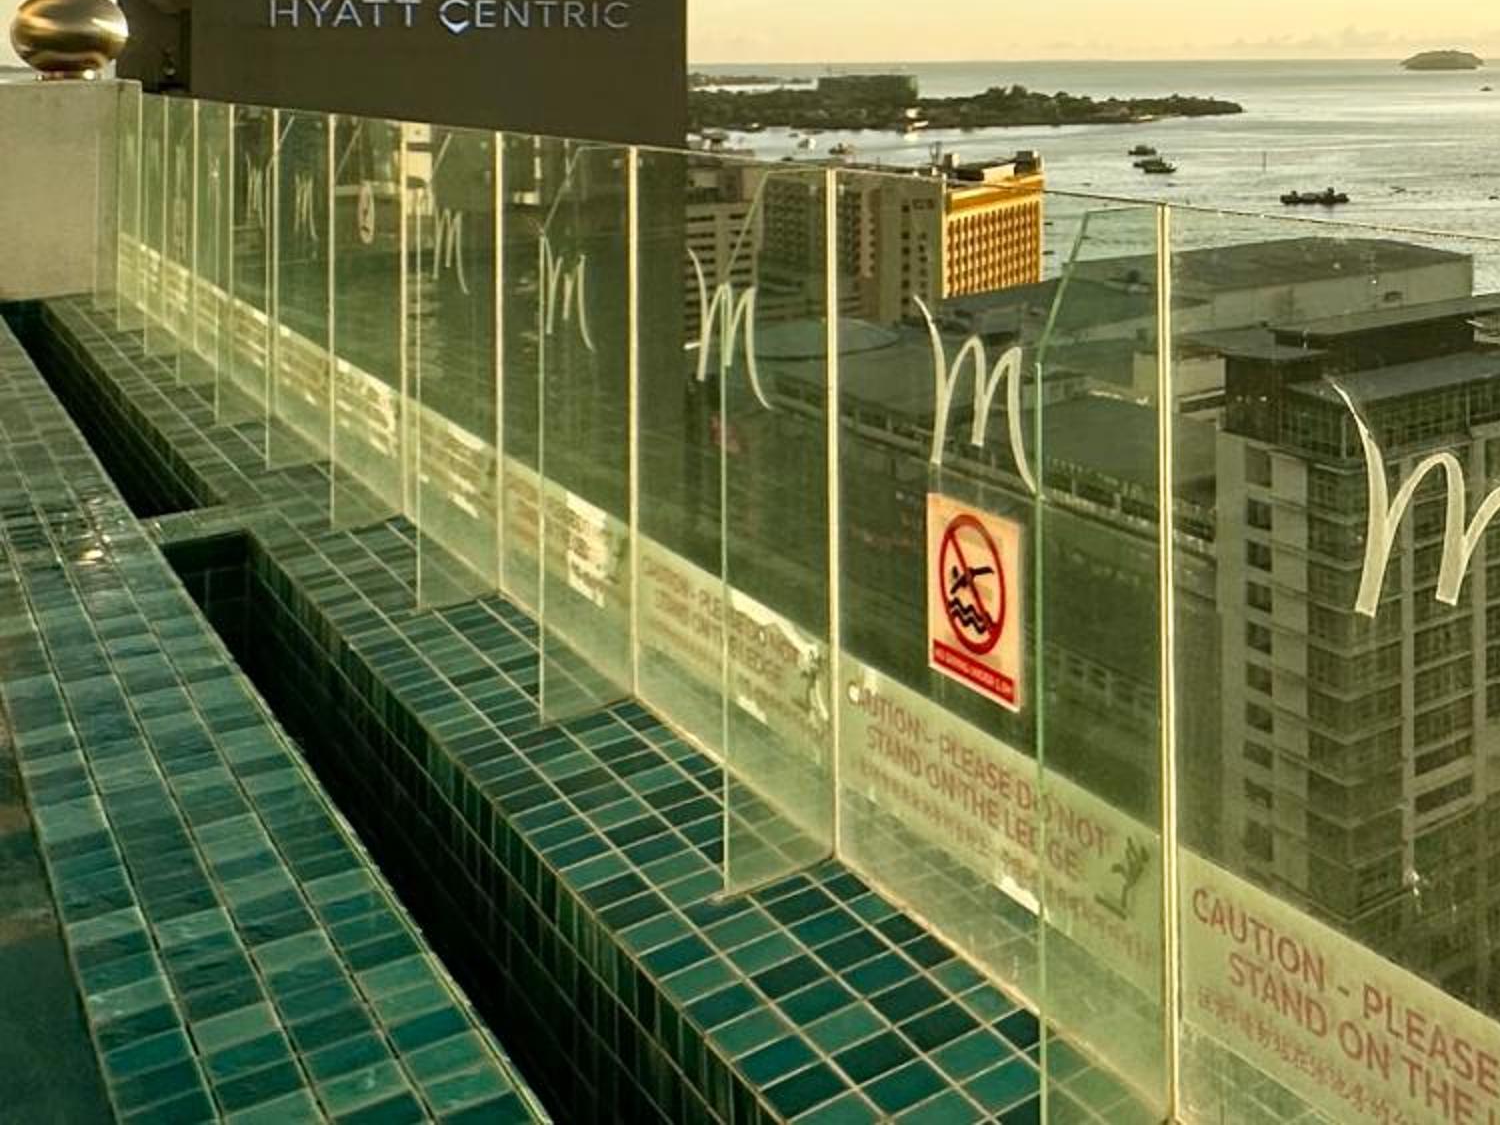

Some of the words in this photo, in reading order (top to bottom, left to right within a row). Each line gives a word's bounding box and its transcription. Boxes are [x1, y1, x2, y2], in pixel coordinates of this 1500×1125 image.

[866, 724, 921, 777] STAND
[926, 762, 954, 801] ON
[960, 780, 998, 829] THE
[940, 733, 1010, 799] PLEASE
[1193, 888, 1325, 992] CAUTION
[1363, 982, 1499, 1099] PLEASE
[1229, 951, 1328, 1038] STAND
[1338, 1020, 1391, 1081] ON
[1401, 1053, 1473, 1125] THE
